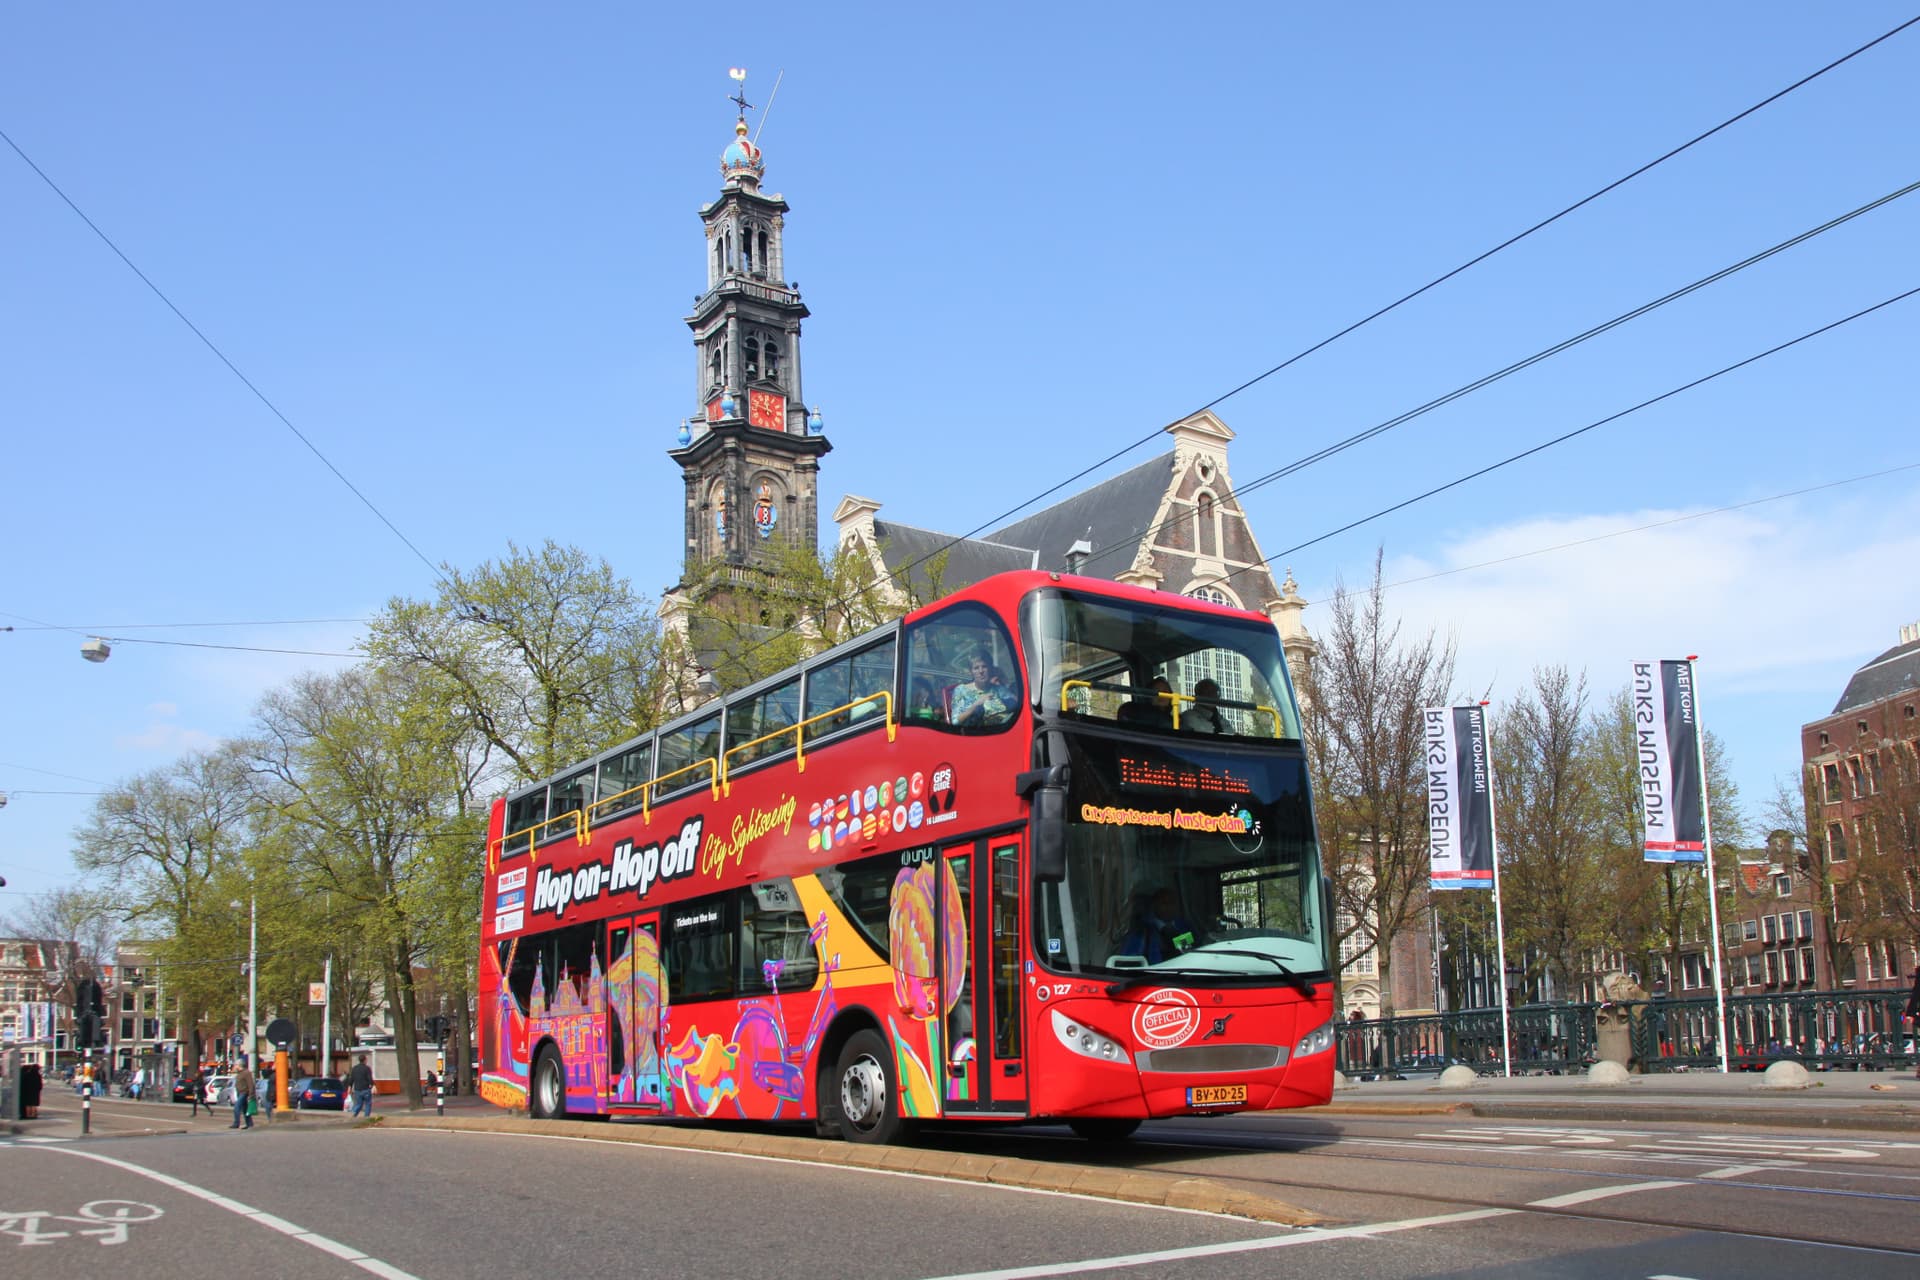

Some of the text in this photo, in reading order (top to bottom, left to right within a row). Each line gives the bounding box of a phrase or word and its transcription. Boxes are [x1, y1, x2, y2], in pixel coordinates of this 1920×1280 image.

[933, 769, 951, 783] GPS
[1173, 808, 1247, 834] Amsterdam
[702, 793, 797, 879] City Sightseeing
[532, 867, 574, 916] Hop
[660, 820, 703, 878] off
[1053, 984, 1072, 995] 127
[1151, 991, 1173, 1002] TOUR
[1145, 1008, 1188, 1028] OFFICIAL
[1153, 1025, 1194, 1046] AMSTERDAM
